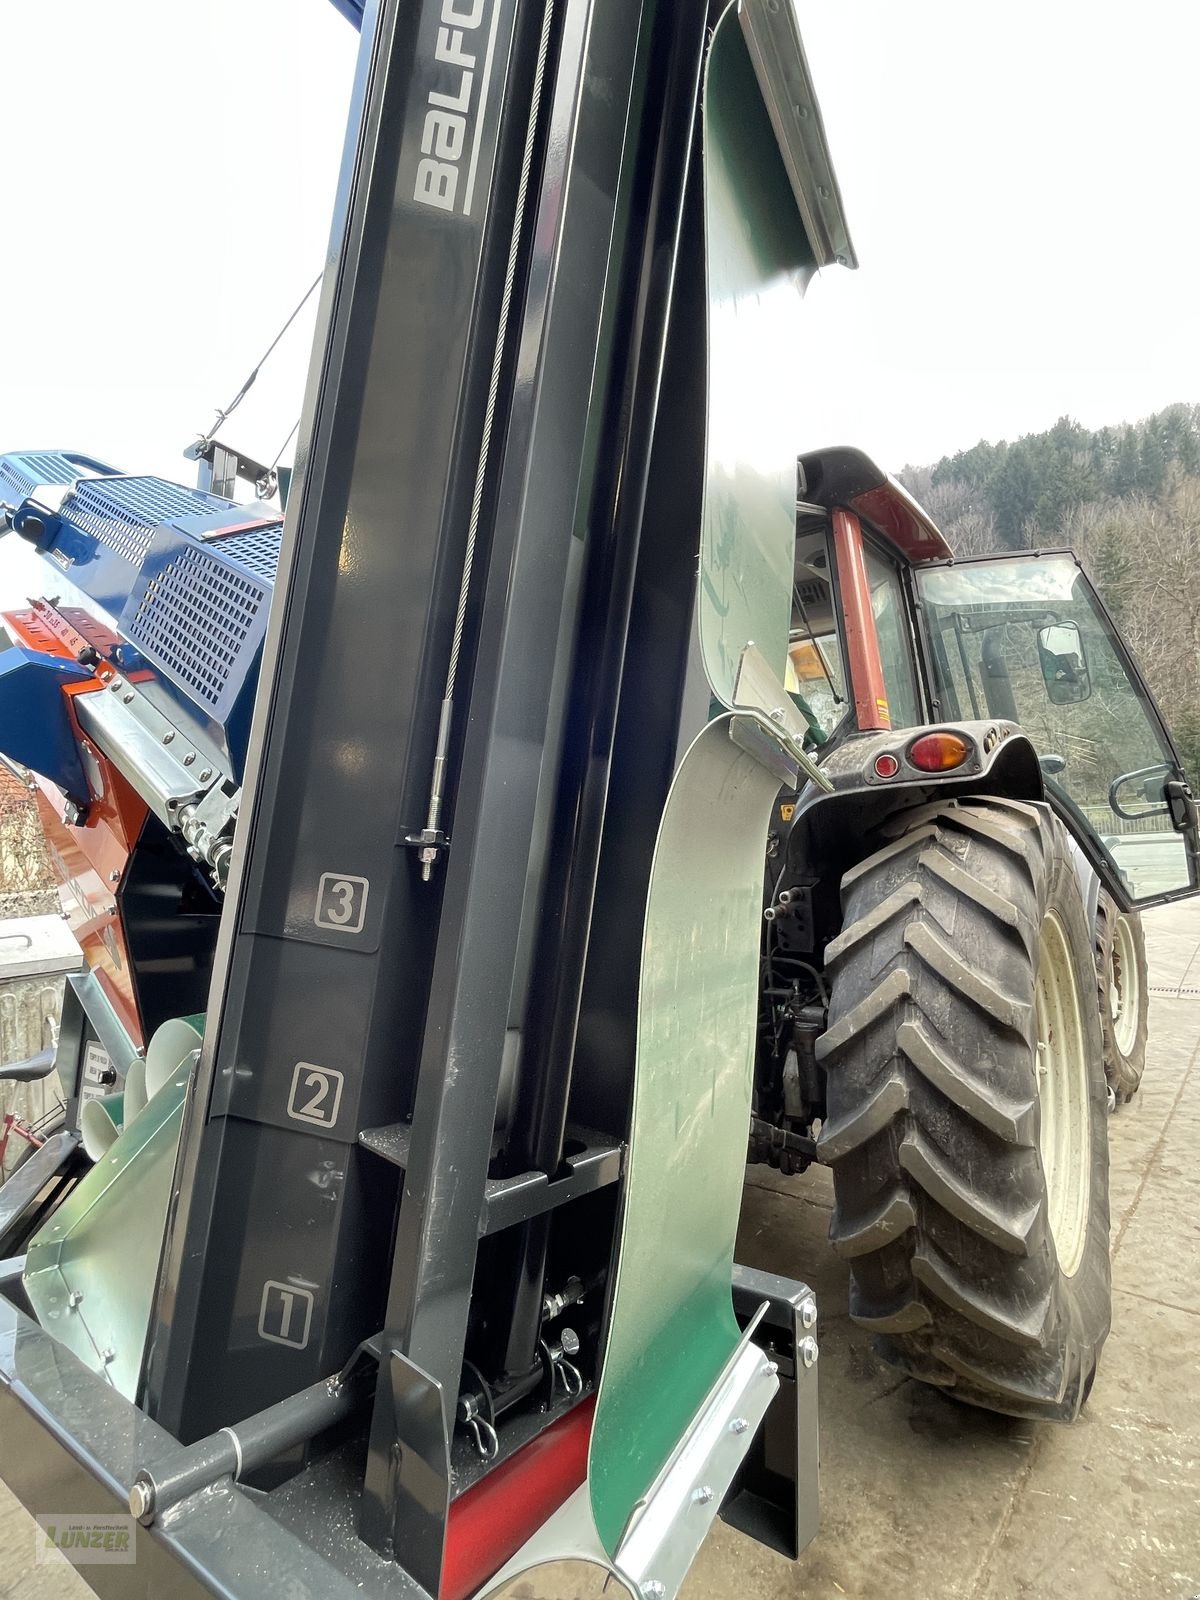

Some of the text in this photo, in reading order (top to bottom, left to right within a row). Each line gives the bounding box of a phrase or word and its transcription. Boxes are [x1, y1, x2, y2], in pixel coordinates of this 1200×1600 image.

[327, 881, 354, 924] 3
[300, 1072, 329, 1119] 2
[280, 1291, 294, 1338] 1
